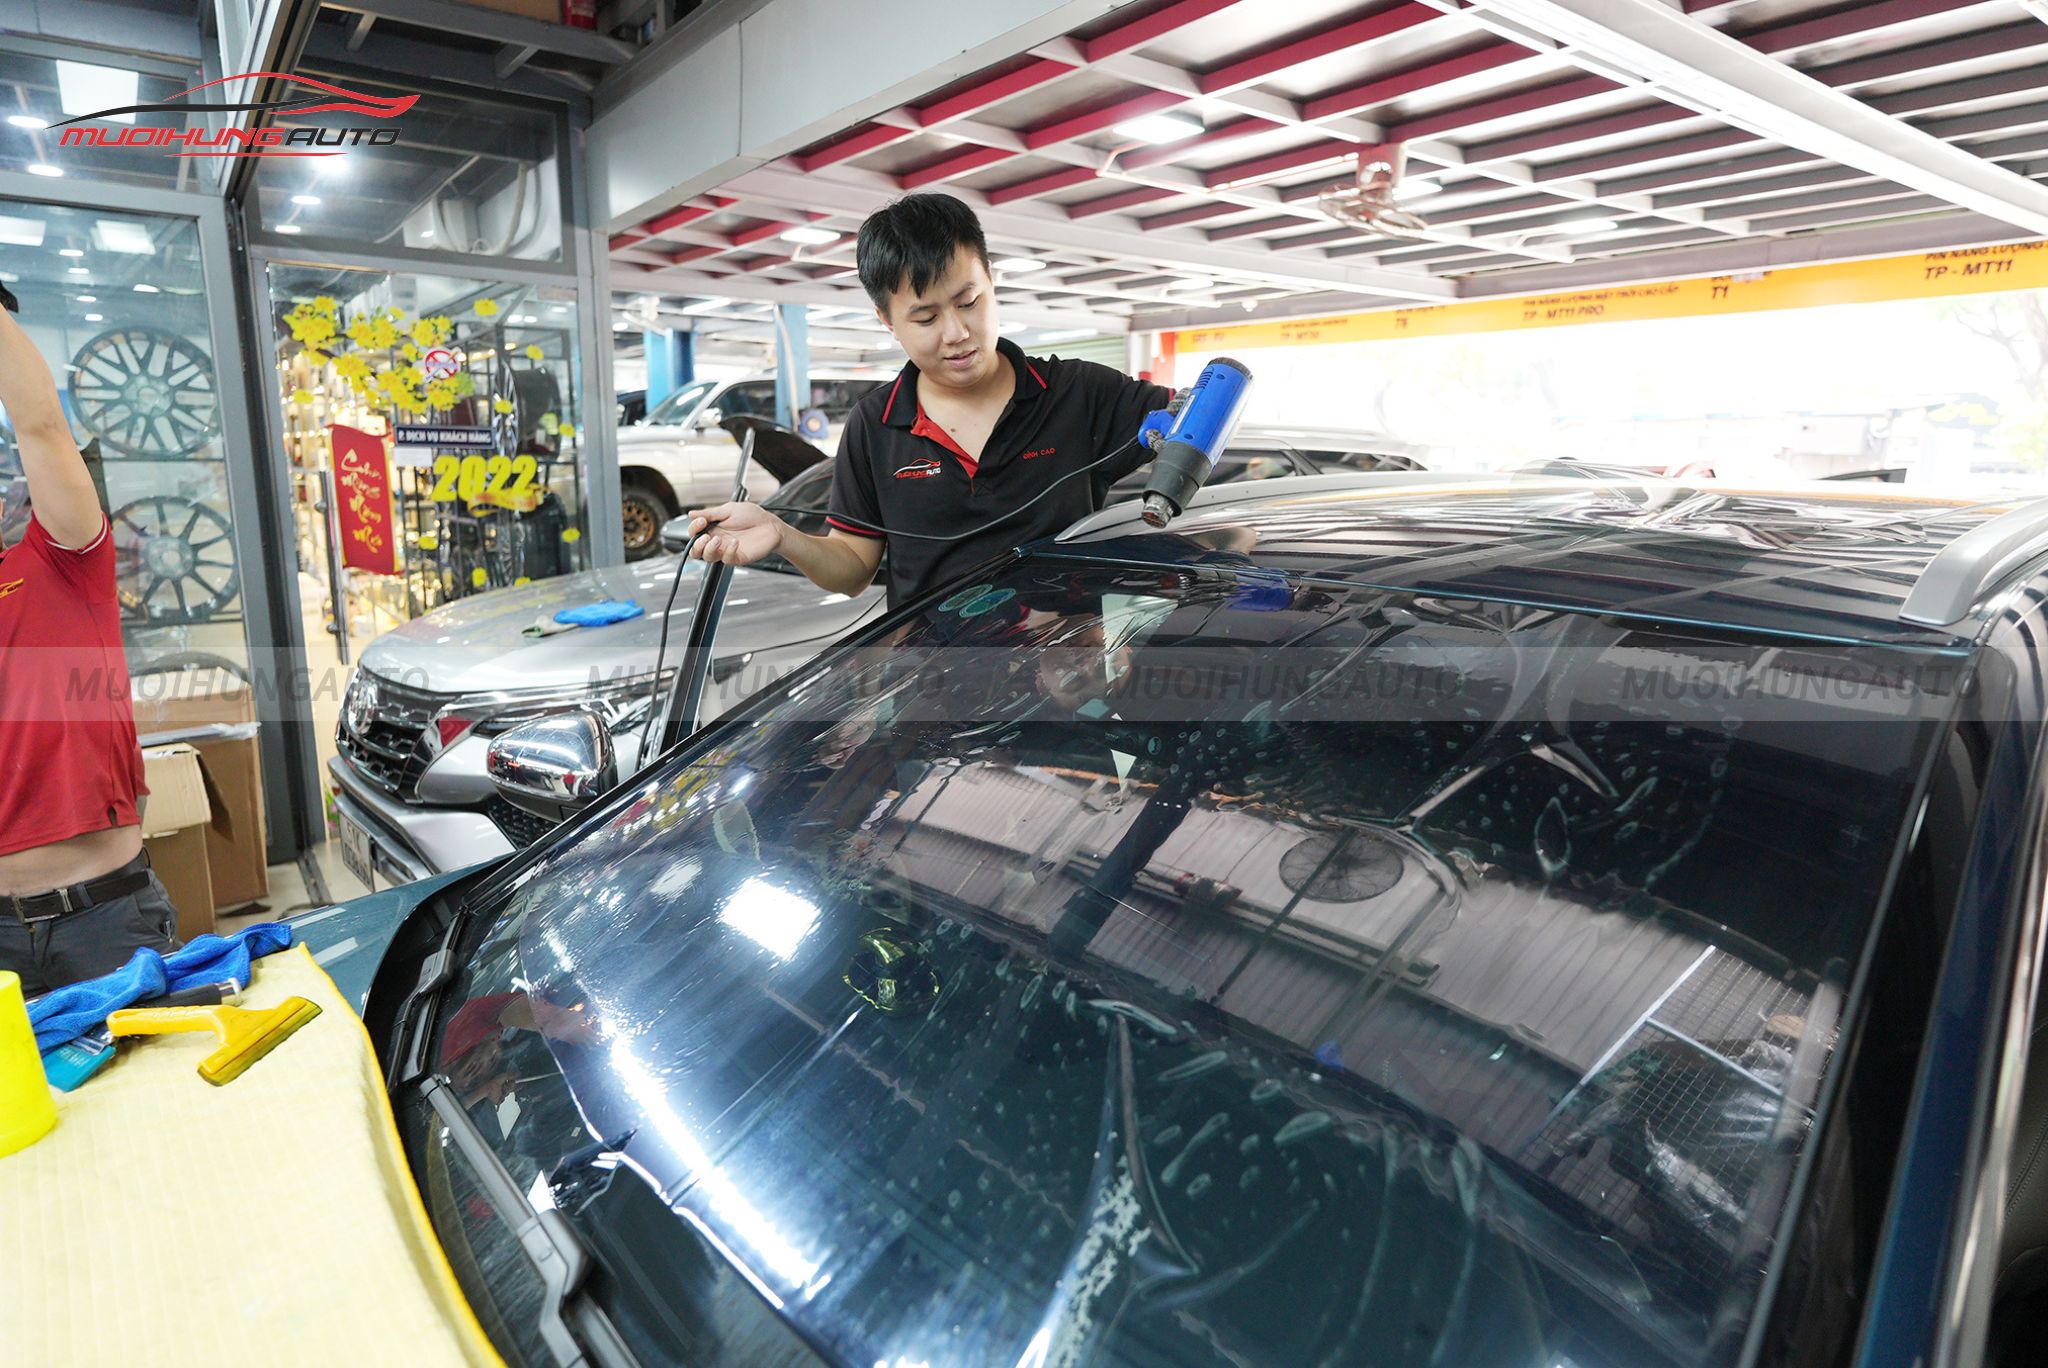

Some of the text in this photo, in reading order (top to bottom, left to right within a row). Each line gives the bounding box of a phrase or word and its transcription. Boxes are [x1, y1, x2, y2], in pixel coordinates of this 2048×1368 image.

[1925, 265, 1948, 280] TP
[1962, 259, 2013, 276] MT11
[1711, 285, 1729, 300] T1
[1040, 447, 1056, 457] CAO
[432, 455, 537, 503] 2022
